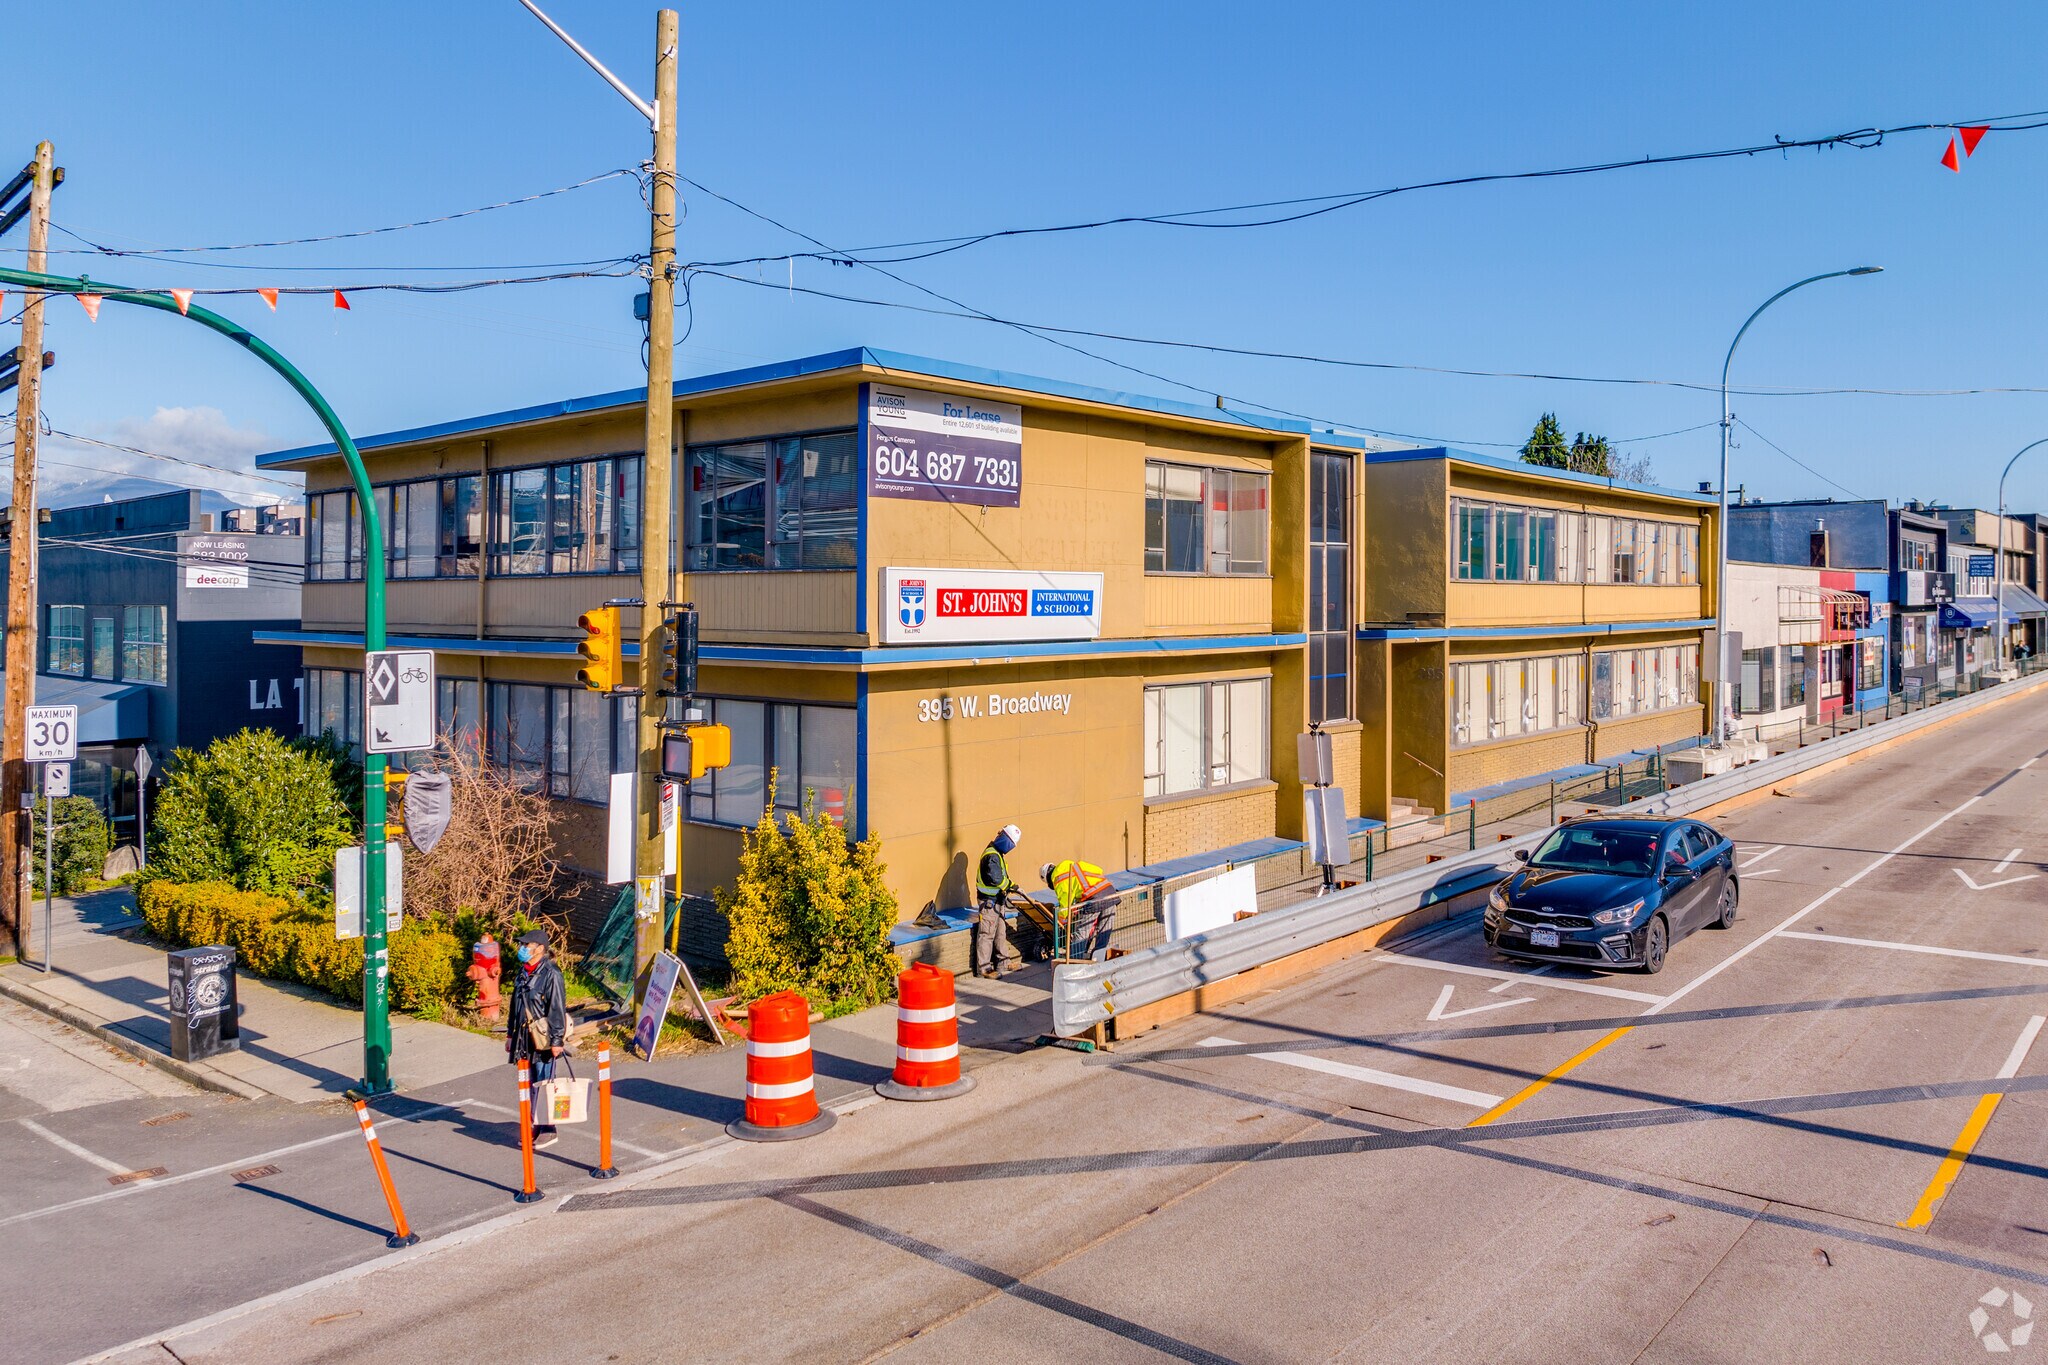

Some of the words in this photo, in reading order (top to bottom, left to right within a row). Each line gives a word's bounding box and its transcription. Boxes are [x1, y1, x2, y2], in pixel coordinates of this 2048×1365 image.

[877, 396, 905, 407] AVISON
[877, 405, 906, 416] YOUNG
[943, 402, 963, 418] For
[966, 405, 1001, 423] Lease
[942, 419, 958, 428] Entire
[981, 423, 1000, 434] building
[999, 426, 1018, 435] available
[893, 436, 916, 445] Cameron
[875, 445, 919, 478] 604
[926, 451, 966, 482] 687
[974, 456, 1018, 487] 7331
[875, 483, 915, 493] avisonyoung.com
[193, 541, 213, 549] NOW
[196, 574, 240, 587] deecorp
[942, 591, 966, 613] ST.
[969, 592, 1023, 614] JOHN'S
[1036, 592, 1090, 602] INTERNATIONAL
[1044, 604, 1081, 614] SCHOOL
[249, 678, 283, 710] LA
[918, 697, 954, 723] 395
[959, 695, 983, 718] W.
[988, 691, 1072, 715] Broadway
[31, 710, 72, 719] MAXIMUM
[33, 721, 69, 747] 30
[39, 748, 63, 757] km/h
